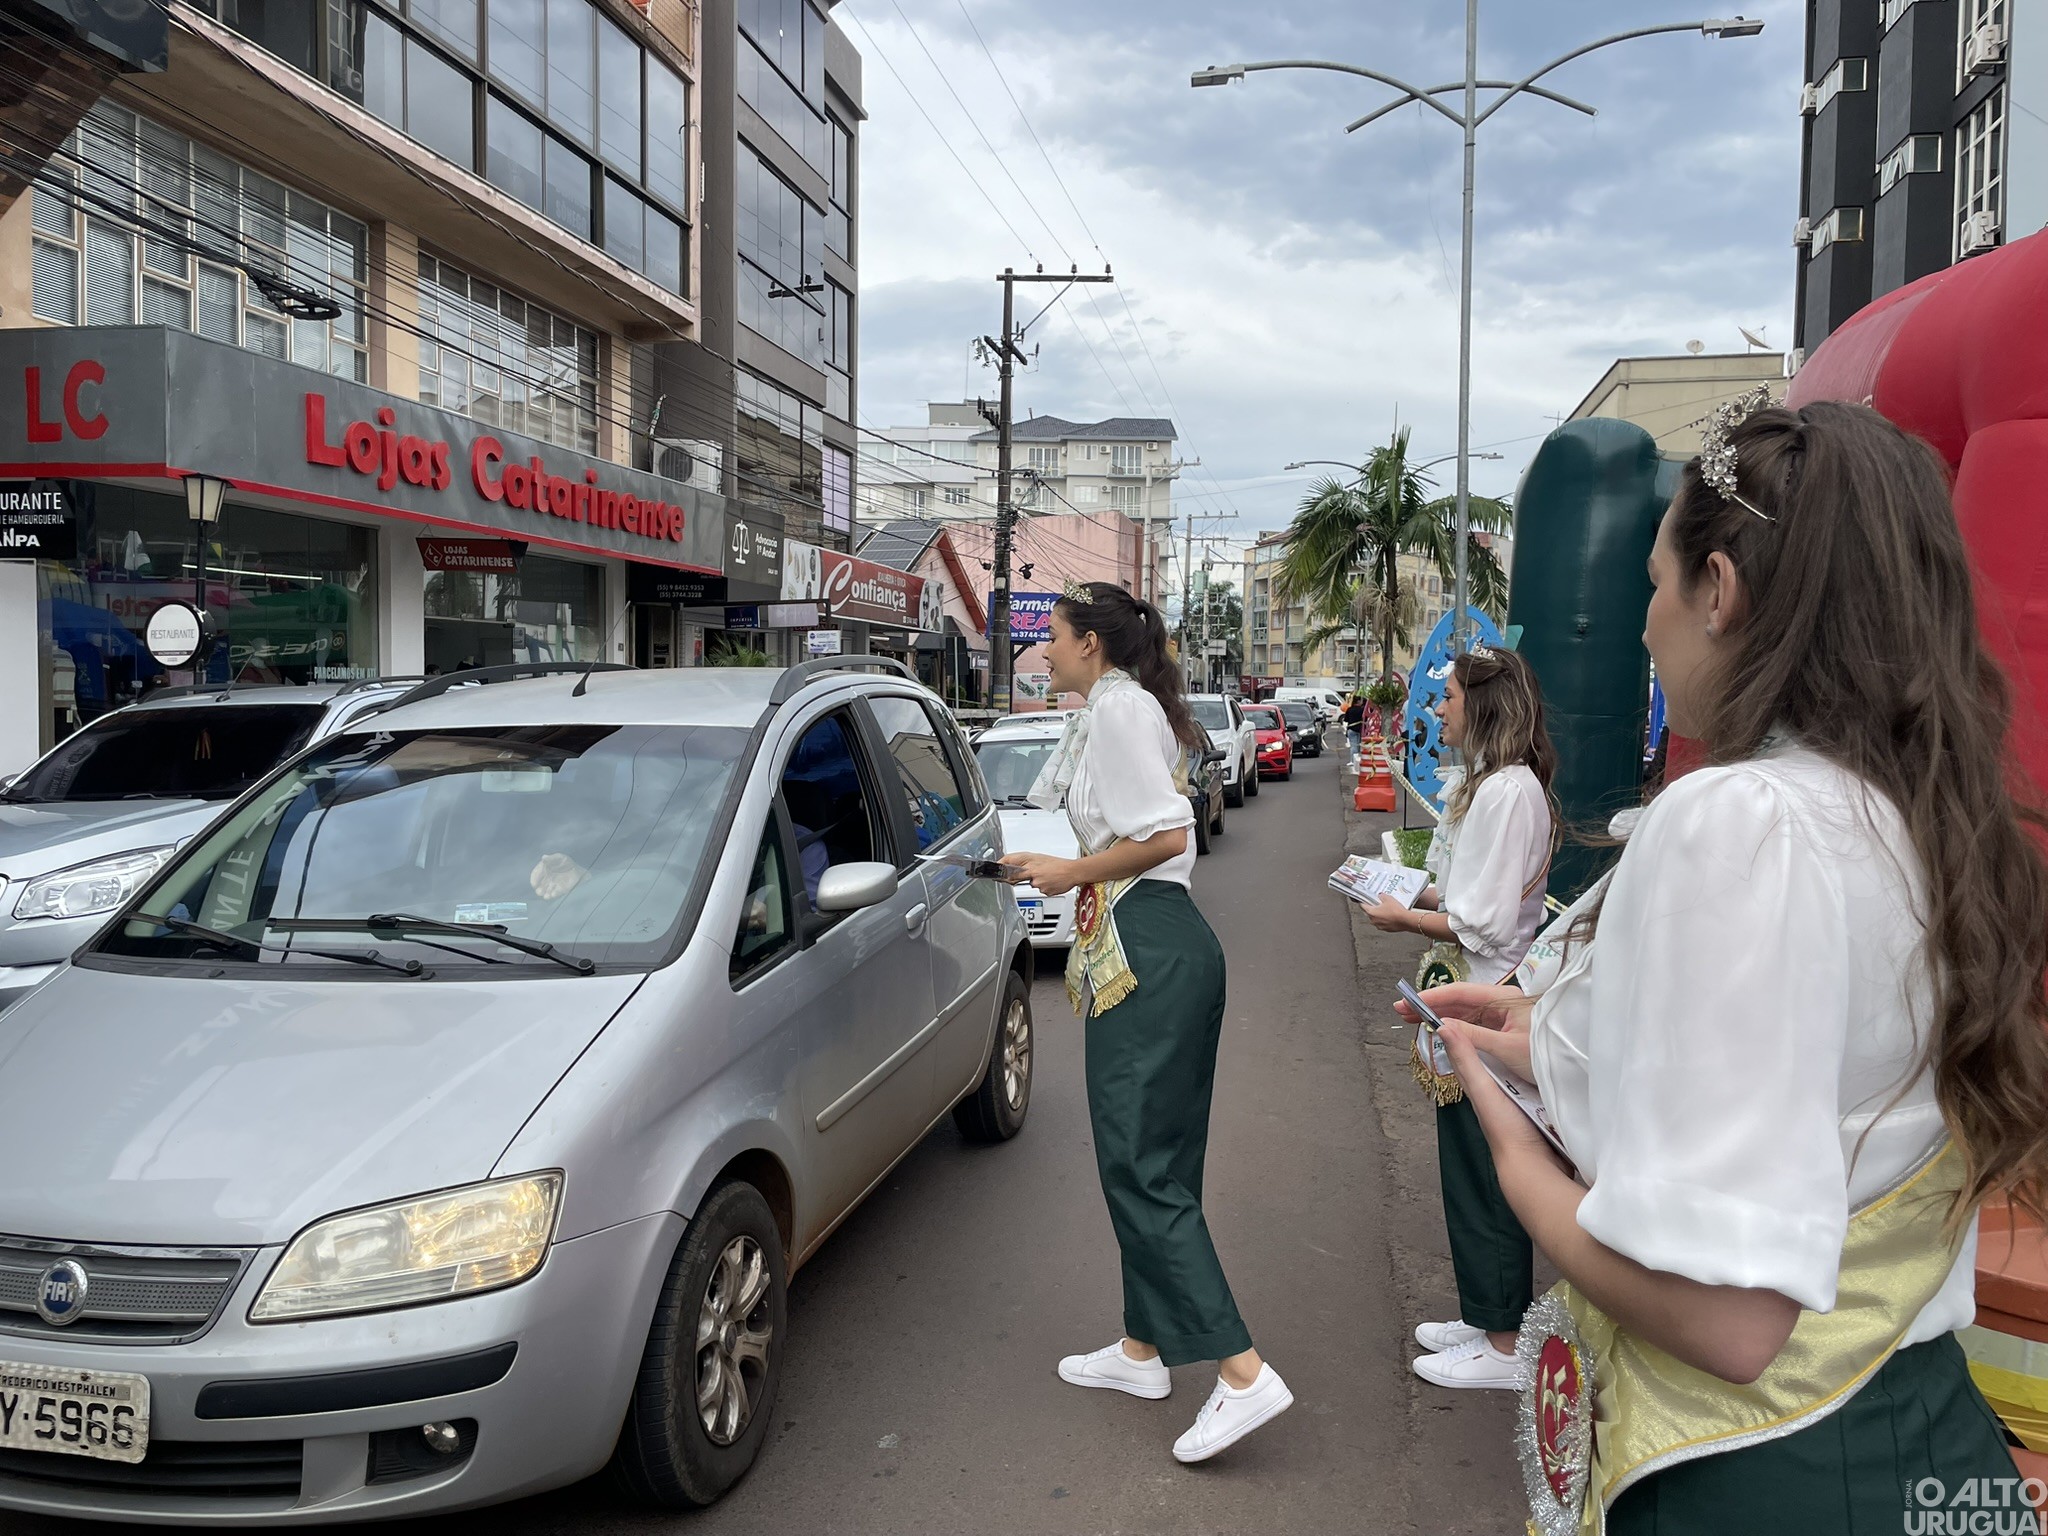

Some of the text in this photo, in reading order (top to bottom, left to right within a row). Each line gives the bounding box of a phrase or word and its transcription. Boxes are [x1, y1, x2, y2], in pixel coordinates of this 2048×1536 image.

[25, 359, 109, 443] LC
[305, 392, 685, 542] Lojas Catarinense
[755, 533, 778, 548] Advocacia
[443, 545, 468, 554] LOJAS
[762, 546, 776, 559] Andar
[445, 555, 514, 567] CATARINENSE
[822, 560, 907, 612] Confiança
[151, 629, 195, 639] RESTAURANTE
[314, 666, 355, 680] PARCELAMOS
[43, 1280, 77, 1303] FIAT
